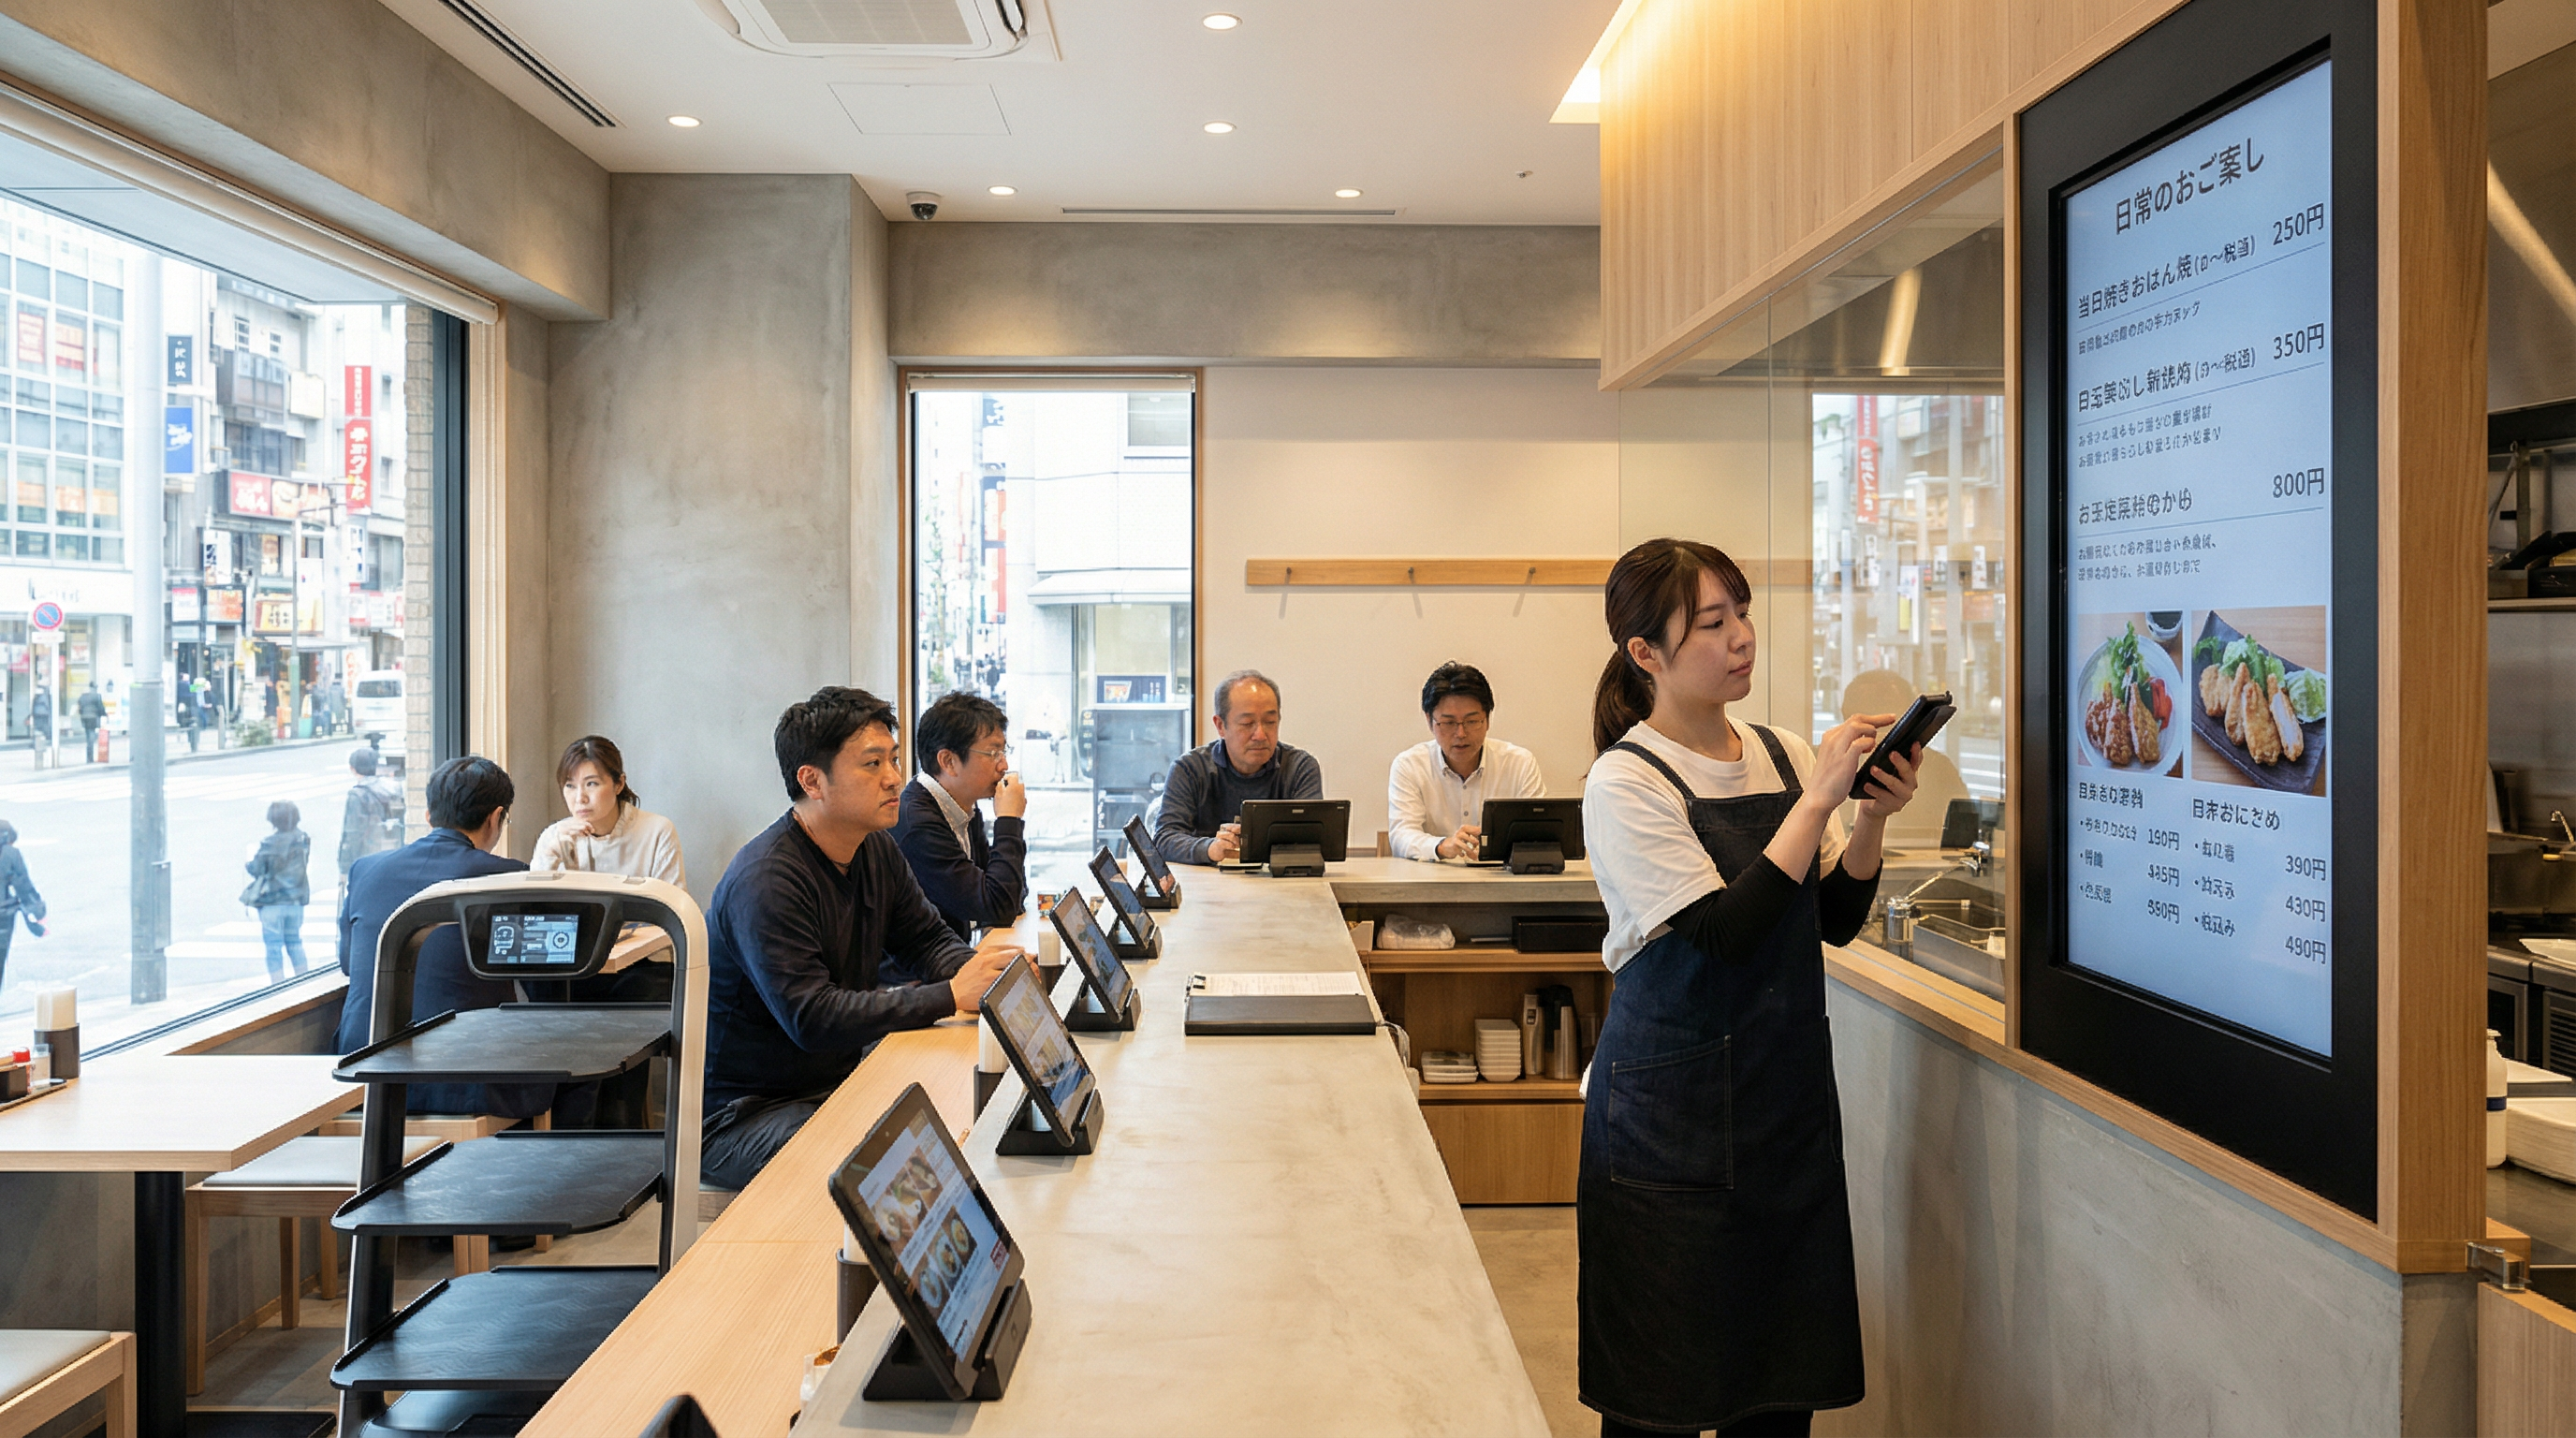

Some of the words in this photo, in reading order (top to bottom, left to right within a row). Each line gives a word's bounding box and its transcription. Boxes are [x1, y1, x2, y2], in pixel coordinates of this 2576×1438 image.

[2115, 138, 2265, 235] 日常のおご案し
[2273, 202, 2325, 245] 250円
[2273, 322, 2325, 360] 350円
[2273, 467, 2325, 498] 800円
[2285, 855, 2327, 882] 390円
[2285, 895, 2327, 922] 430円
[2285, 935, 2327, 965] 490円
